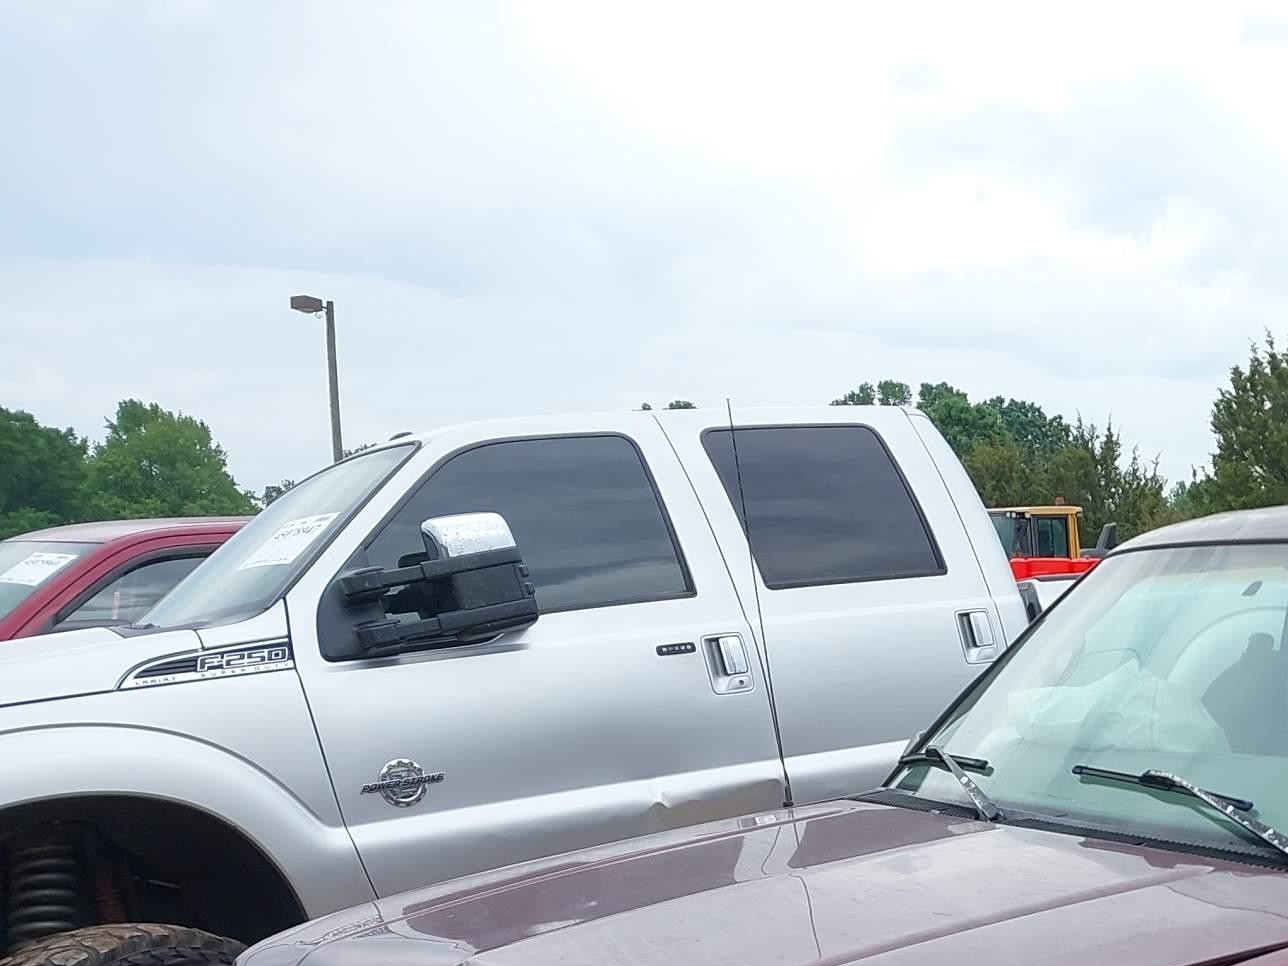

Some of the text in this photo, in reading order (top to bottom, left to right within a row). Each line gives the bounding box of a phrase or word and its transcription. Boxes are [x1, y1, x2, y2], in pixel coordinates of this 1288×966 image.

[196, 647, 289, 672] F-250
[200, 662, 289, 678] SUPER DUTY
[360, 781, 400, 795] POWER
[401, 772, 445, 785] STROKE
